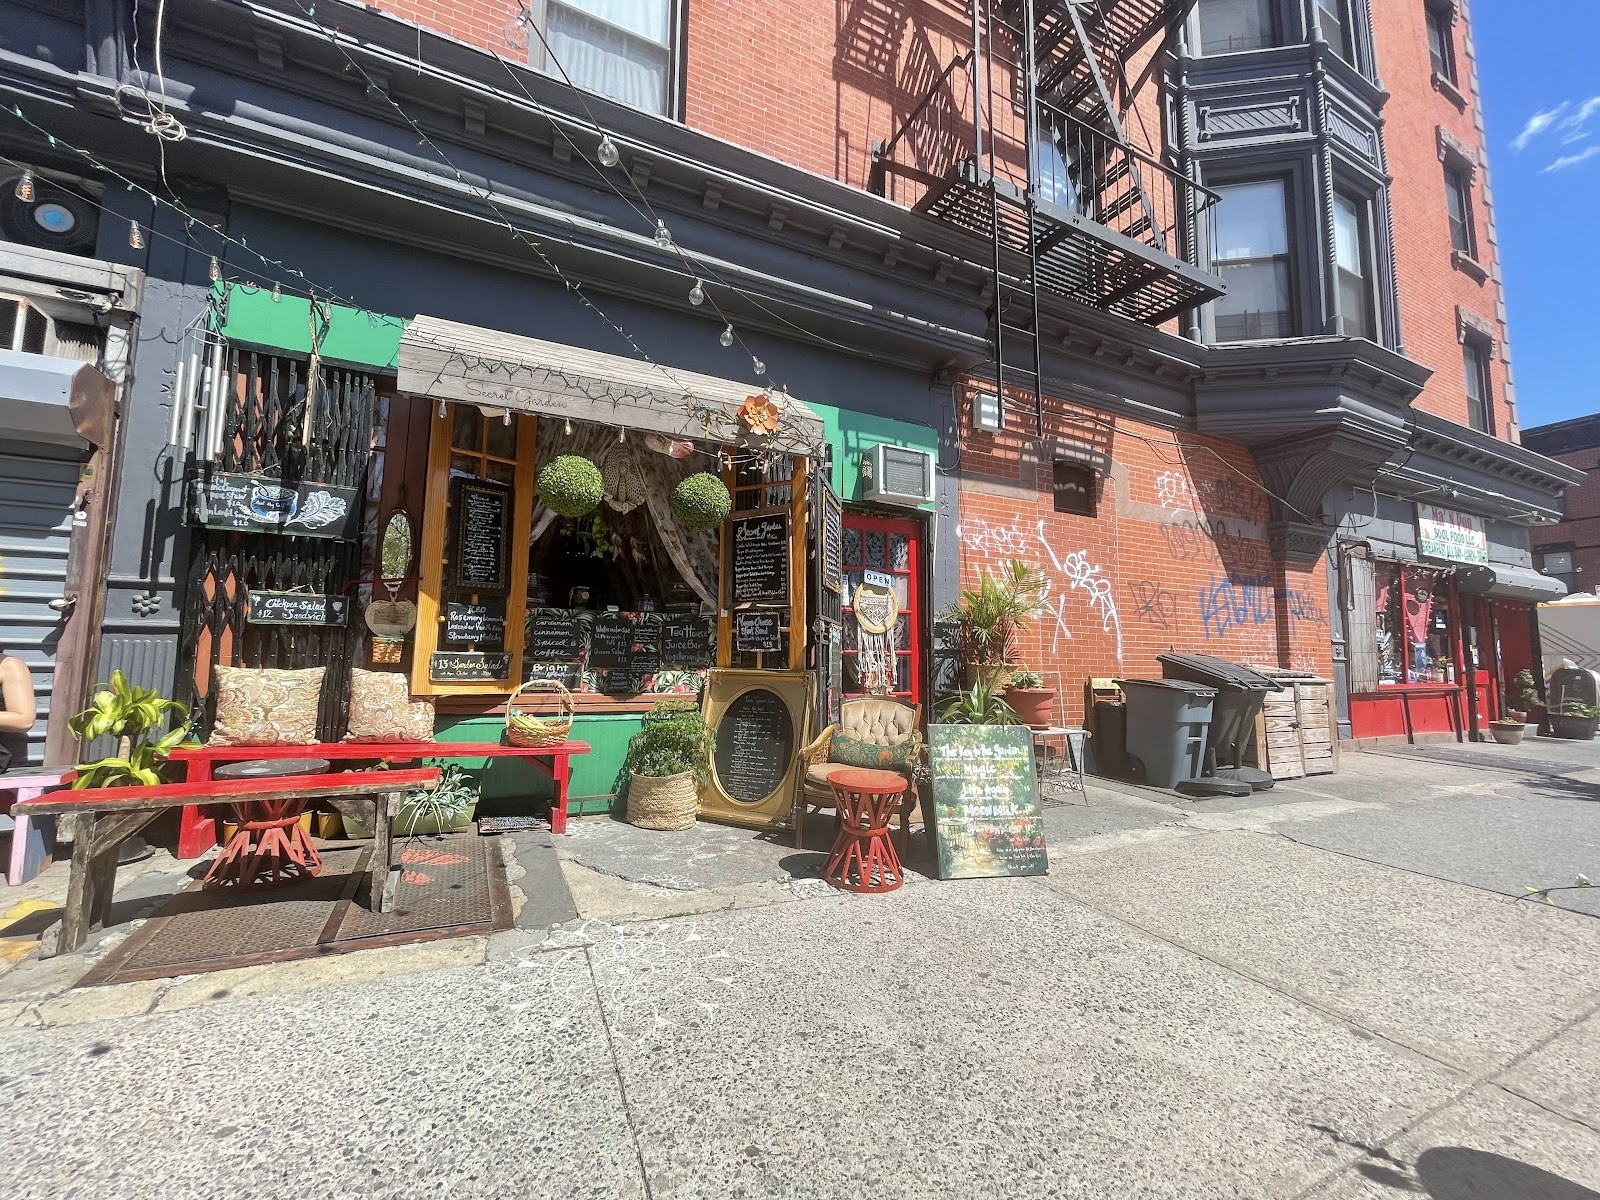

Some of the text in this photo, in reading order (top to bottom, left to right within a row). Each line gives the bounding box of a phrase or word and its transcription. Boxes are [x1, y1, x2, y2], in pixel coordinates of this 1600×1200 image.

[466, 381, 567, 411] Secret Garden
[1450, 531, 1465, 544] FOOD
[1465, 535, 1476, 546] LLC
[866, 573, 890, 585] OPEN
[265, 598, 326, 612] Chickpea Salad
[467, 605, 486, 614] ICED
[257, 608, 326, 621] $12 Sandwich
[450, 611, 483, 624] Rosemary
[534, 648, 572, 657] coffee
[532, 663, 569, 673] Bright
[963, 761, 997, 778] Magic
